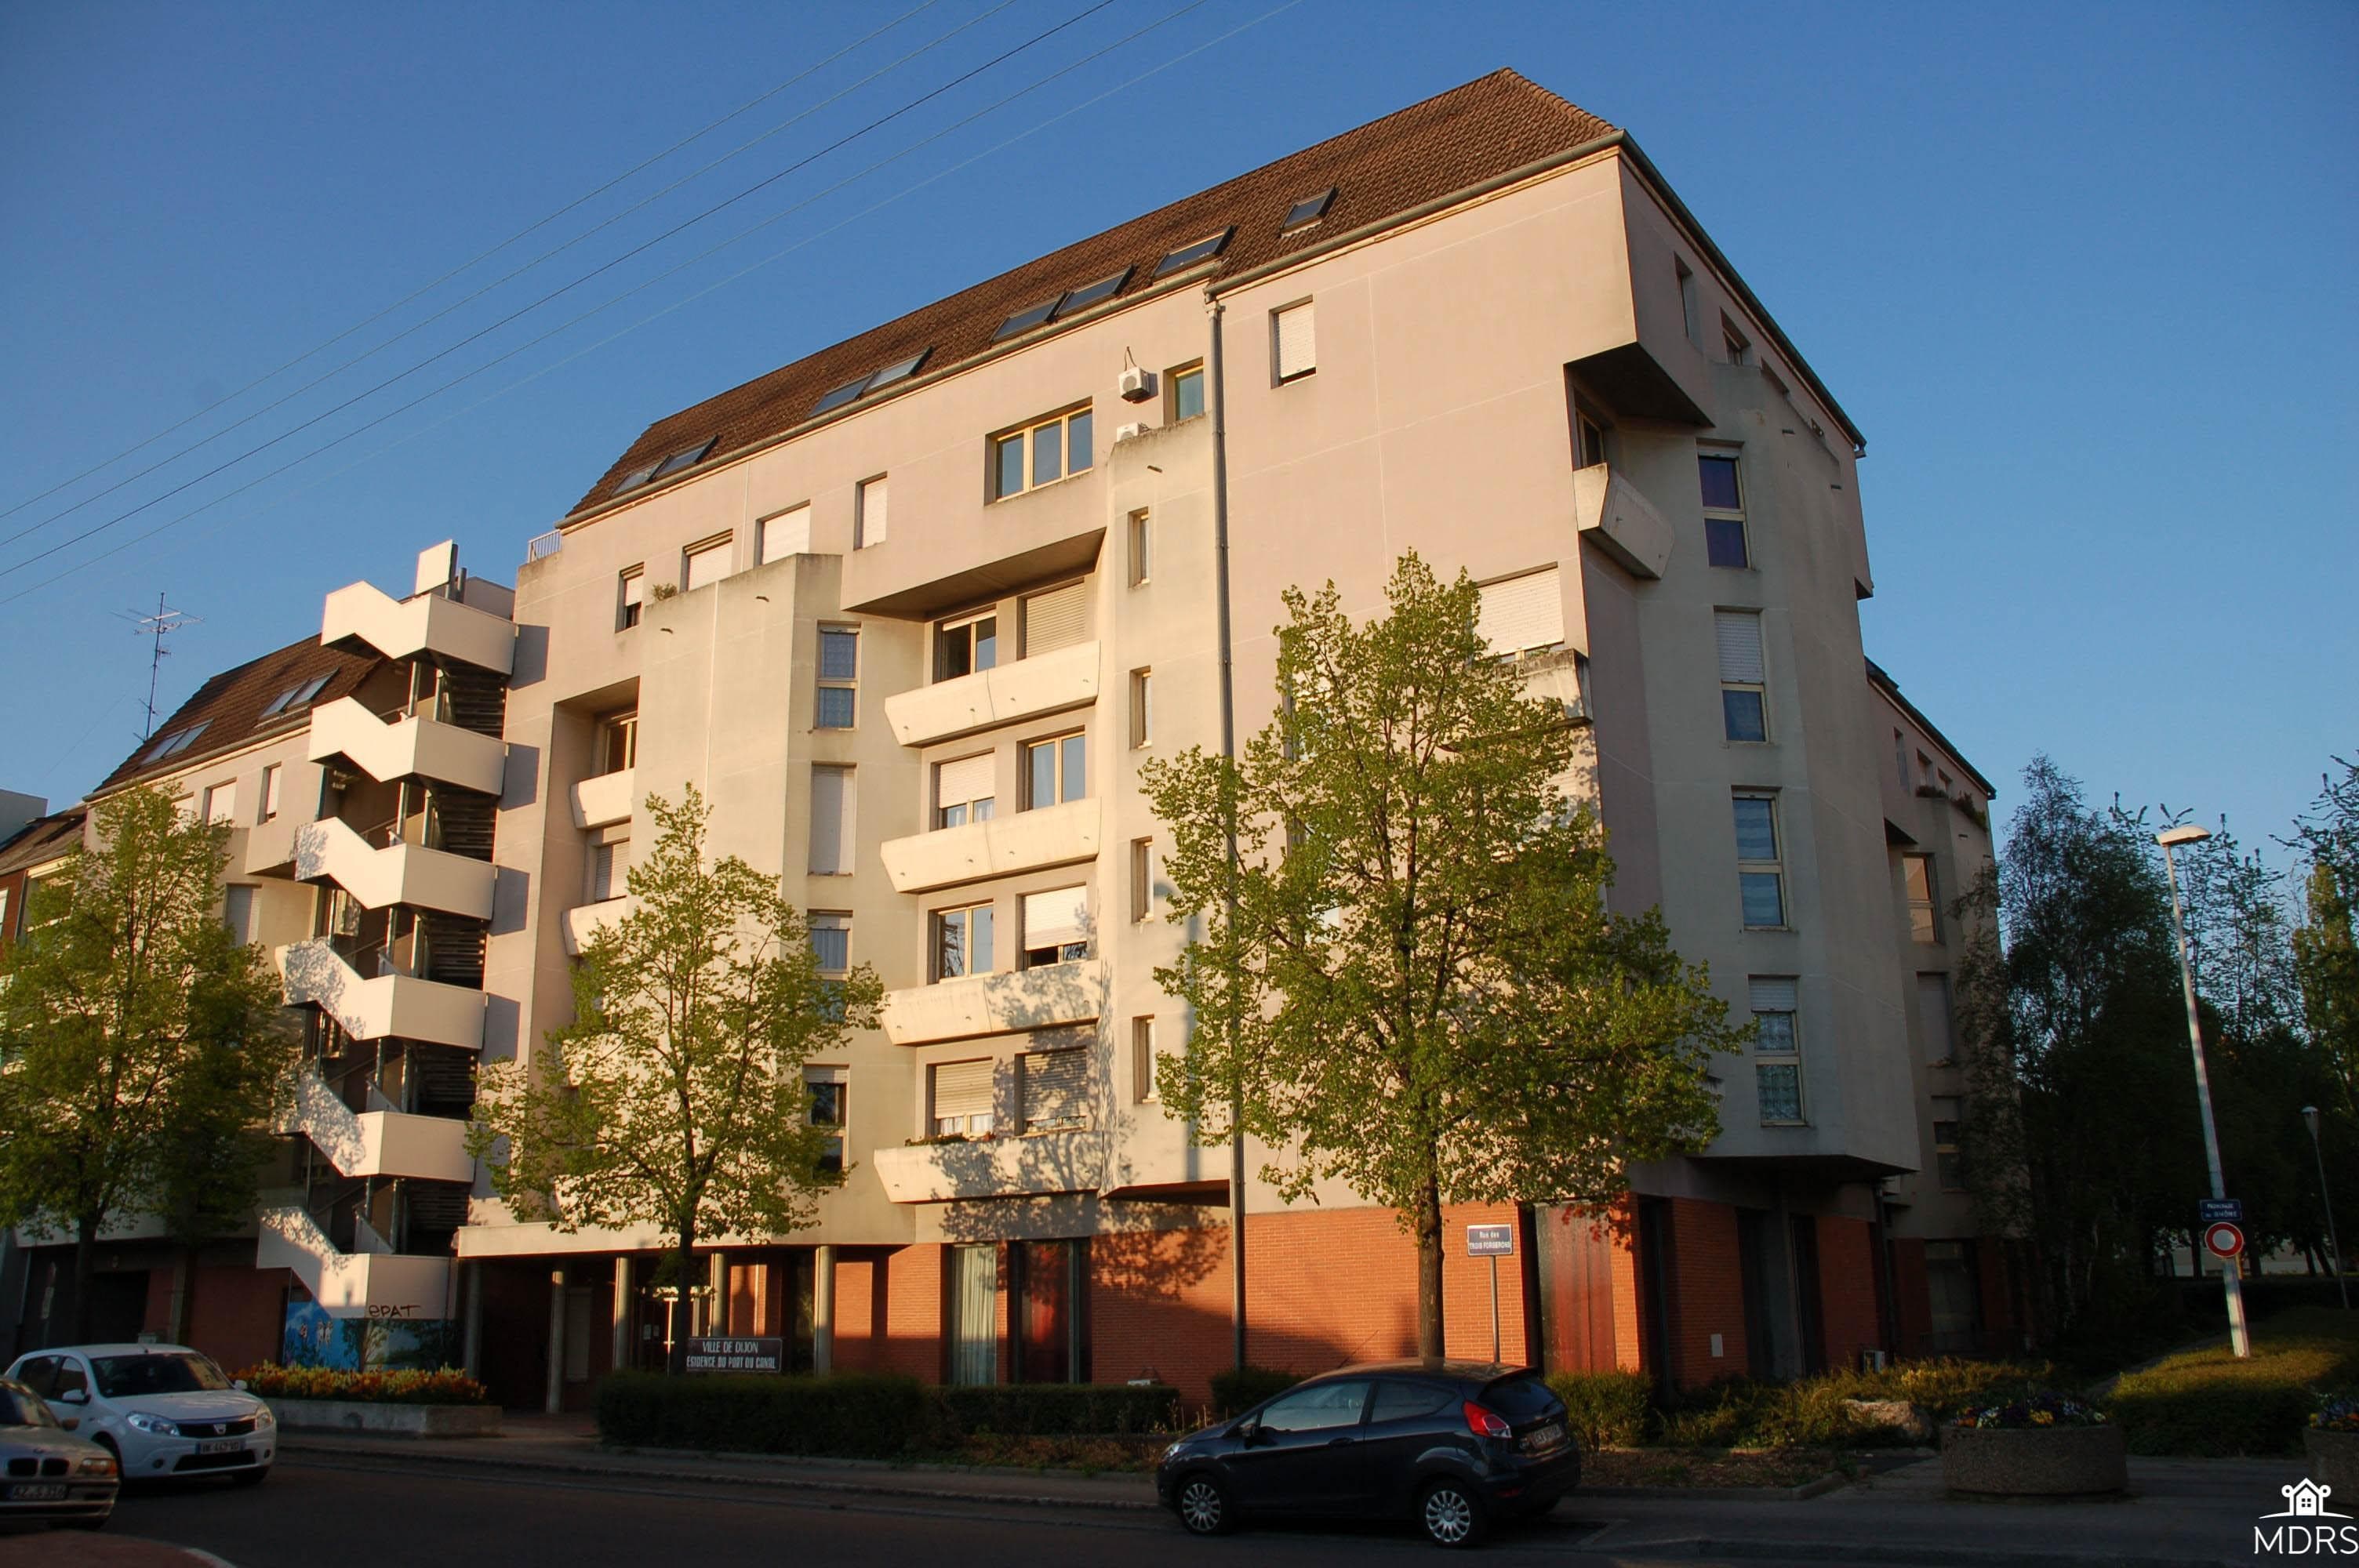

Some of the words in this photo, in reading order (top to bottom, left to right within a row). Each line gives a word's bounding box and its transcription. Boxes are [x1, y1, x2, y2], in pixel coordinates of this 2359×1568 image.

[702, 1341, 721, 1353] VILLE
[723, 1341, 733, 1353] DE
[735, 1341, 758, 1354] DIJON
[728, 1356, 743, 1368] PORT
[756, 1356, 776, 1369] CANAL
